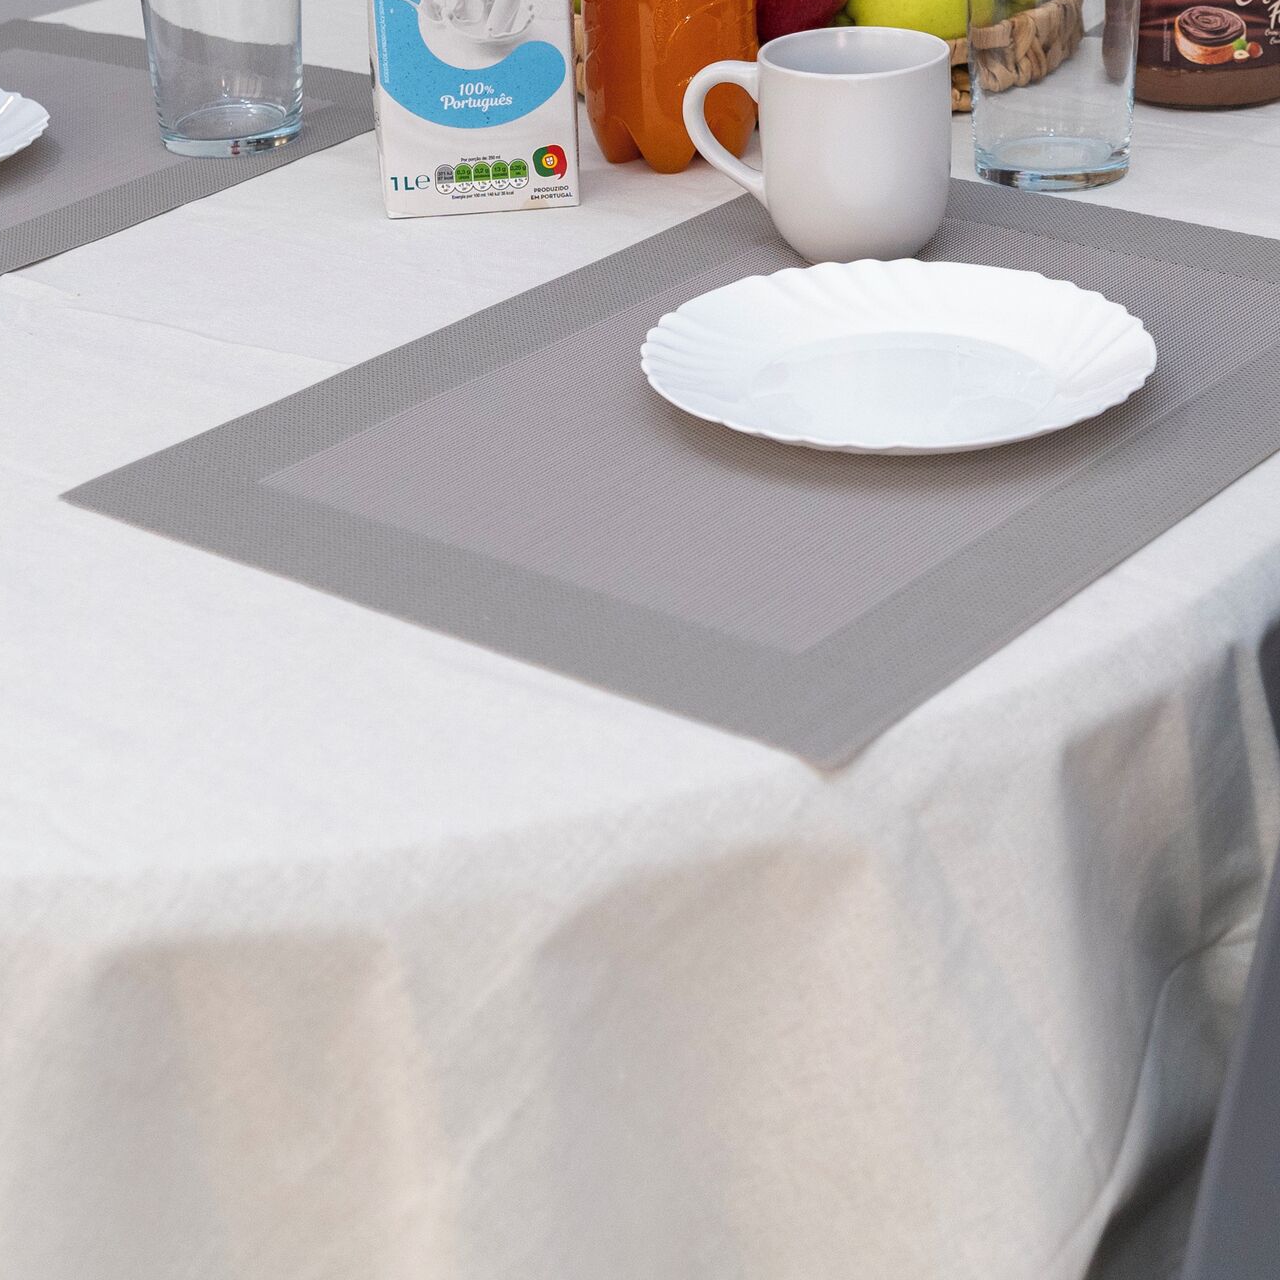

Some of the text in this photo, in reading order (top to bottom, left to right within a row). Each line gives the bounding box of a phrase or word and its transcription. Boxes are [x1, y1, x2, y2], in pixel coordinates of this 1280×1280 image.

[459, 82, 495, 96] 100%
[440, 93, 513, 112] Português
[534, 185, 569, 193] PRODUZIDO
